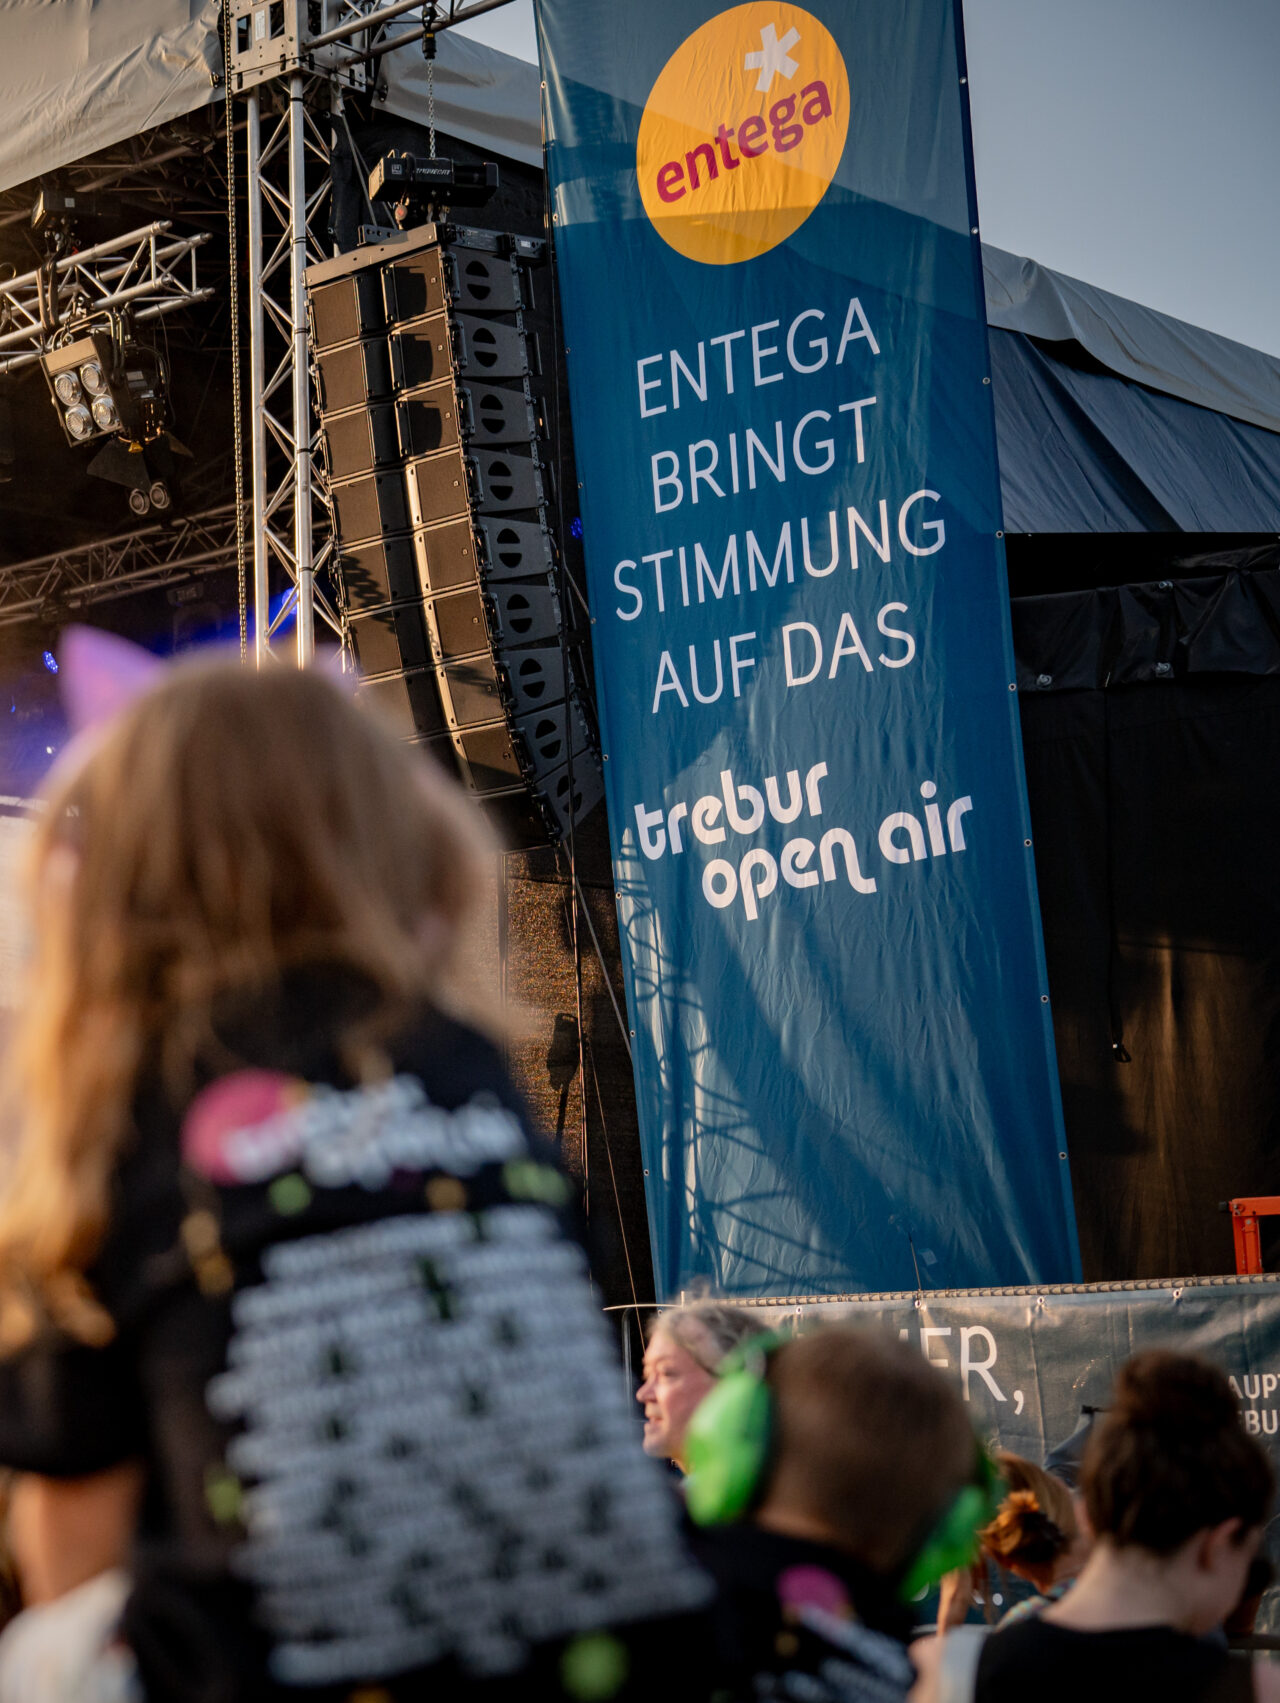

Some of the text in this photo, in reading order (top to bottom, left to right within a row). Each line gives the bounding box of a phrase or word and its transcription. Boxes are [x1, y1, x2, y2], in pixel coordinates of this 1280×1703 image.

[656, 80, 833, 204] entega
[636, 297, 881, 419] ENTEGA
[651, 396, 877, 514] BRINGT
[613, 489, 946, 621] STIMMUNG
[652, 601, 917, 714] AUF DAS
[633, 761, 828, 861] trebur
[701, 780, 973, 921] open air
